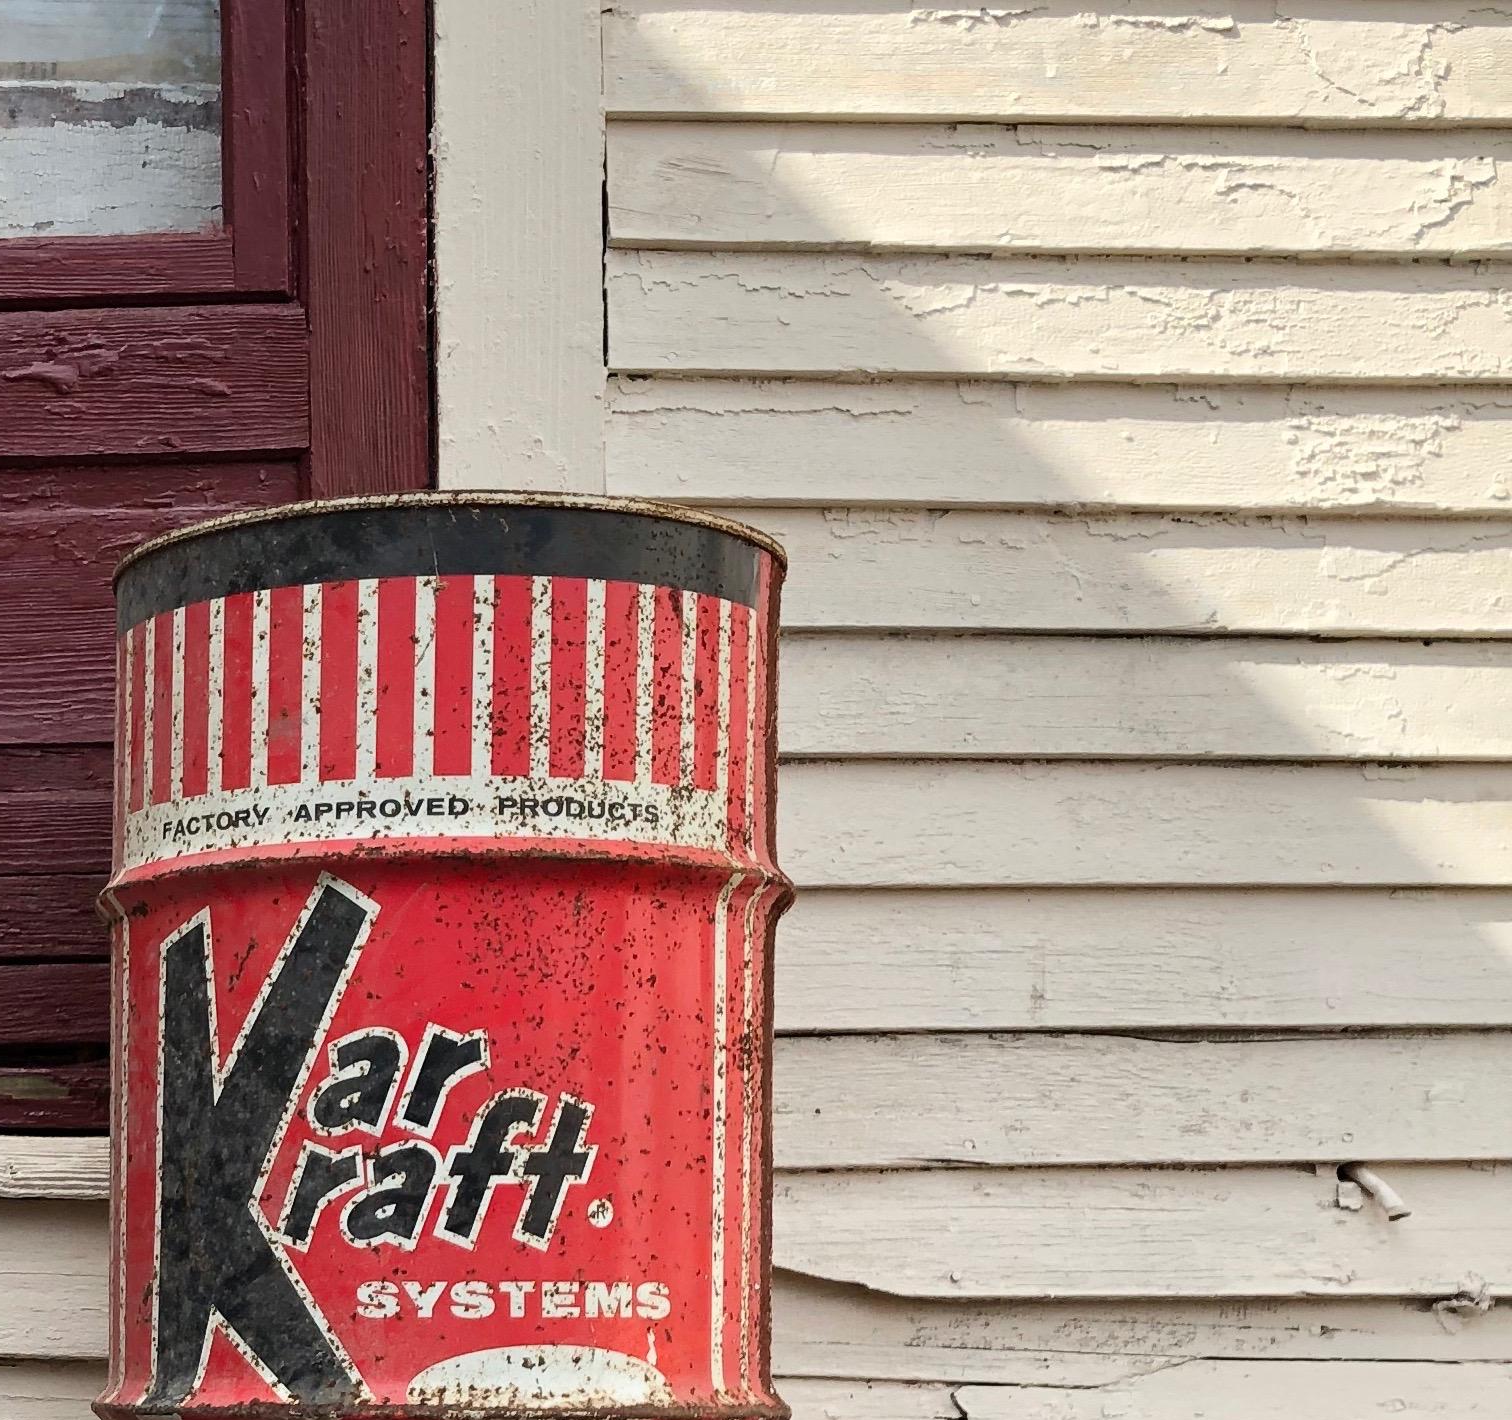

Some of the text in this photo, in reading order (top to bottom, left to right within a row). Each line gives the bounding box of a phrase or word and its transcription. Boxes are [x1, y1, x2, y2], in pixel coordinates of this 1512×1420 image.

[161, 797, 660, 839] FACTORY APPROVED PRODUCTS
[354, 1279, 672, 1320] SYSTEMS
